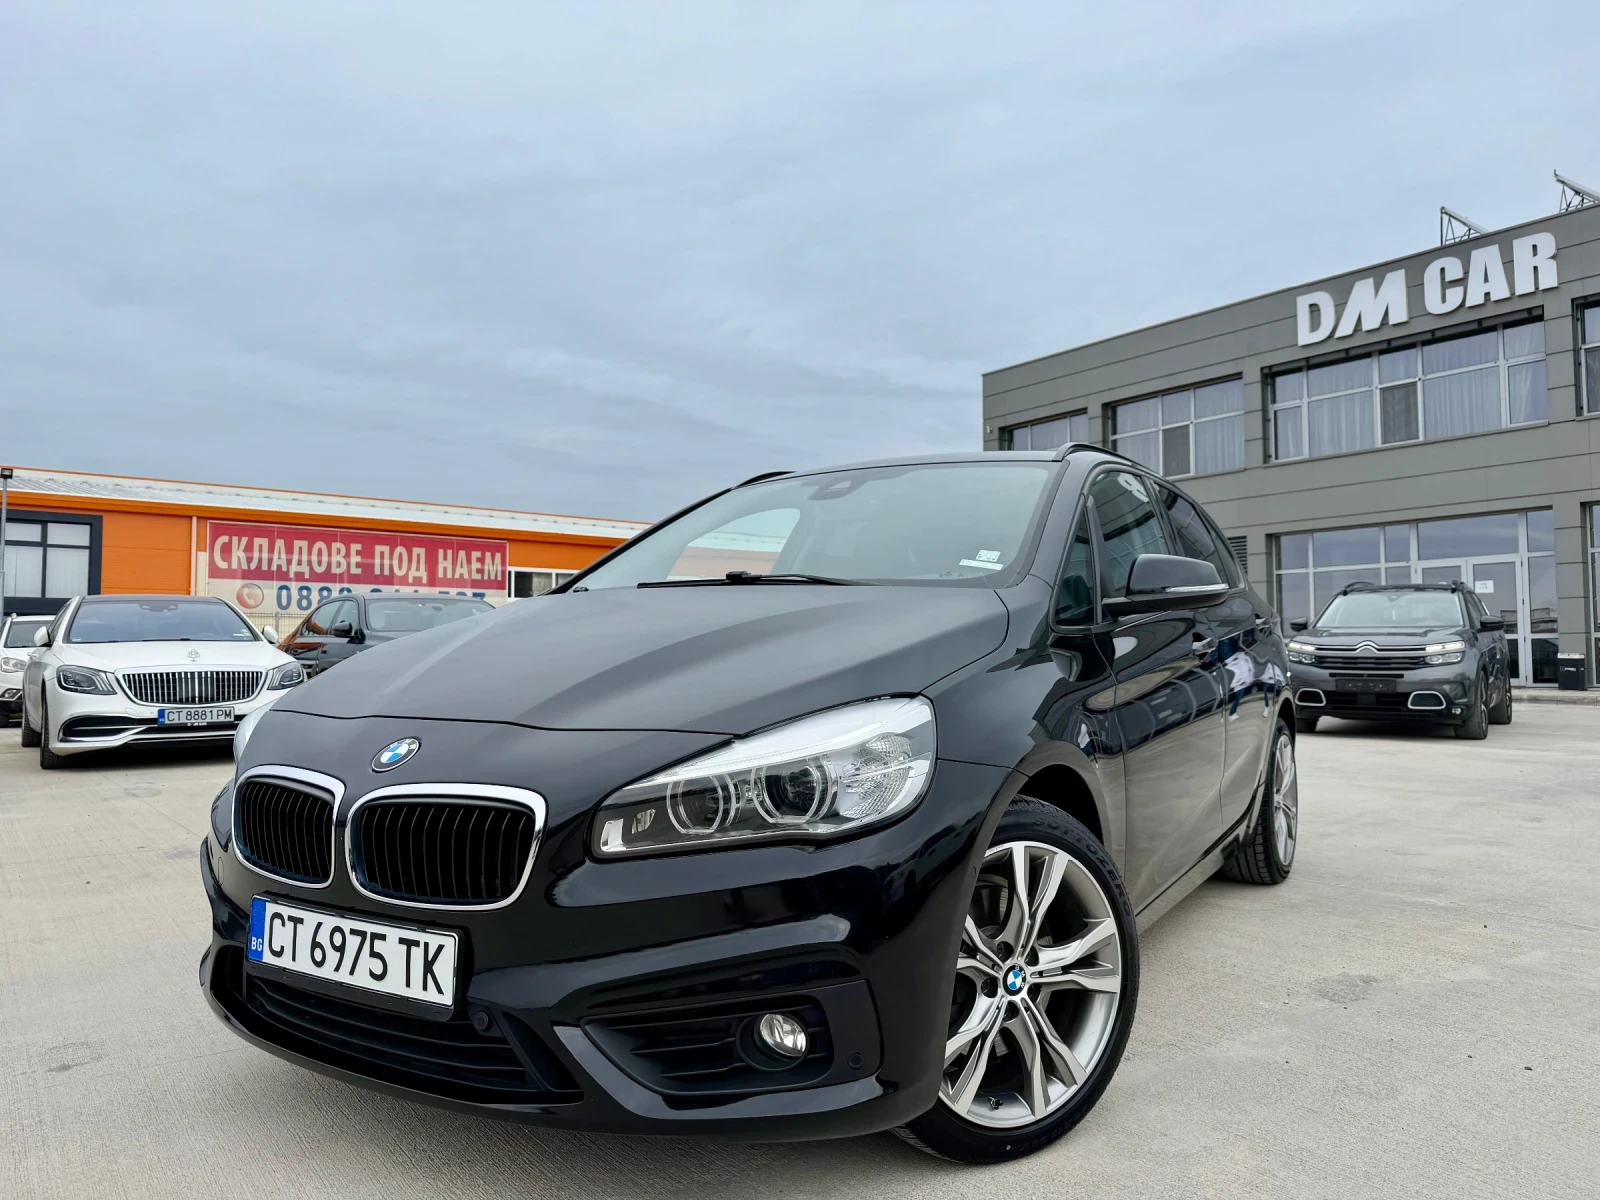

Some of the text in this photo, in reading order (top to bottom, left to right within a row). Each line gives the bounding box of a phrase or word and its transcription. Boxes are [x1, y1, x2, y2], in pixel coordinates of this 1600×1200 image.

[1296, 231, 1559, 347] DM CAR
[213, 534, 502, 584] СКЛАДОВЕ ПОД НАЕМ
[167, 708, 232, 722] CT 8881 PM
[251, 936, 263, 951] BG
[268, 912, 446, 995] CT 6975 TK
